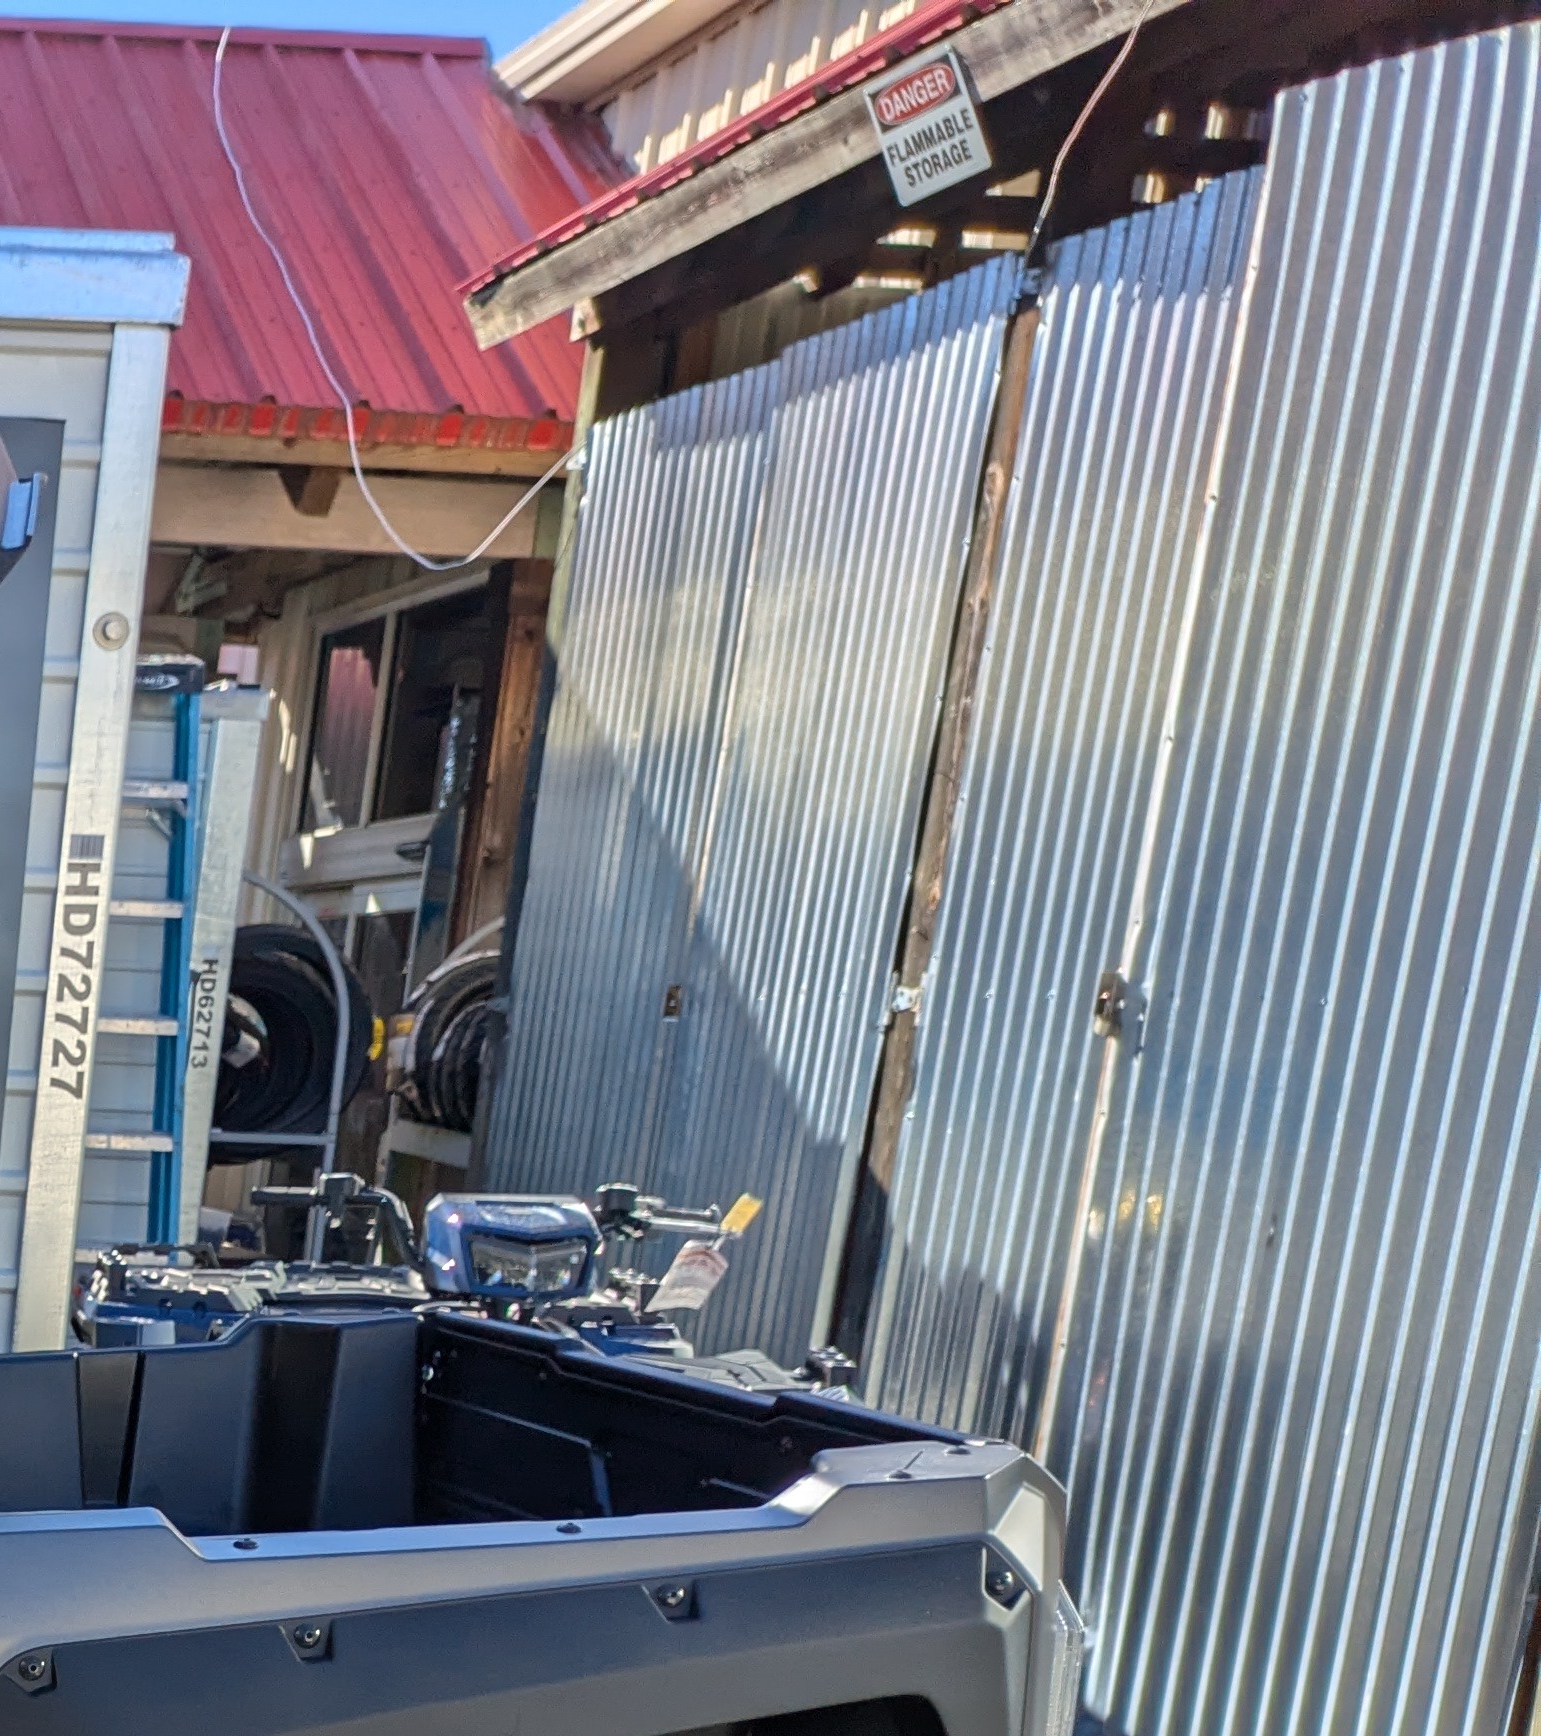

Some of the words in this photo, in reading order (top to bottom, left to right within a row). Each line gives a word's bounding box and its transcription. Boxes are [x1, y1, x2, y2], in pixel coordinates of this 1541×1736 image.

[880, 68, 951, 121] DANGER
[886, 108, 974, 167] FLAMMABLE
[903, 140, 973, 188] STORAGE
[49, 861, 102, 1100] HD72727
[191, 959, 219, 1070] HD62713
